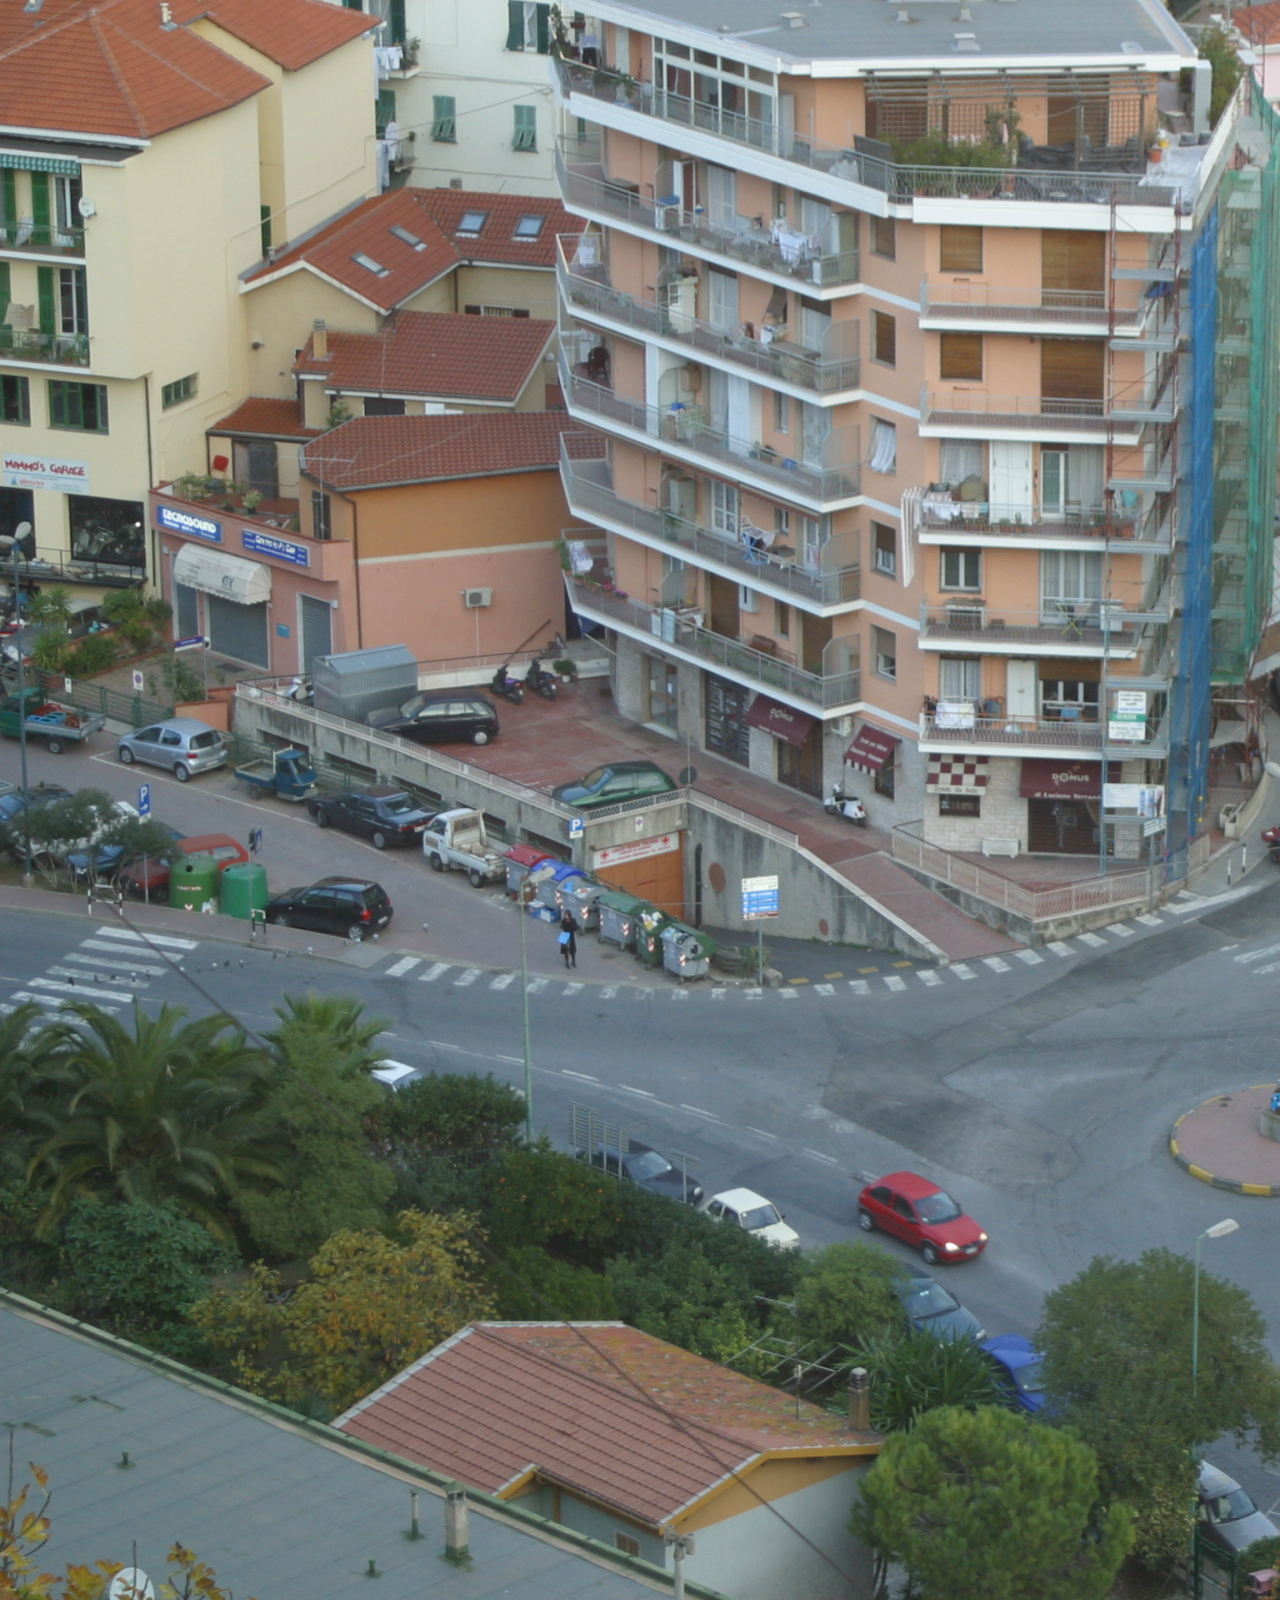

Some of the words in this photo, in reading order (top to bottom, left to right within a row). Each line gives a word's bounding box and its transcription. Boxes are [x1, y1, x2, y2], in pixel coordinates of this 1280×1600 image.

[5, 460, 46, 472] MIMMO'S
[50, 464, 85, 476] GARAGE
[1052, 773, 1090, 782] DOMUS
[572, 819, 582, 831] P
